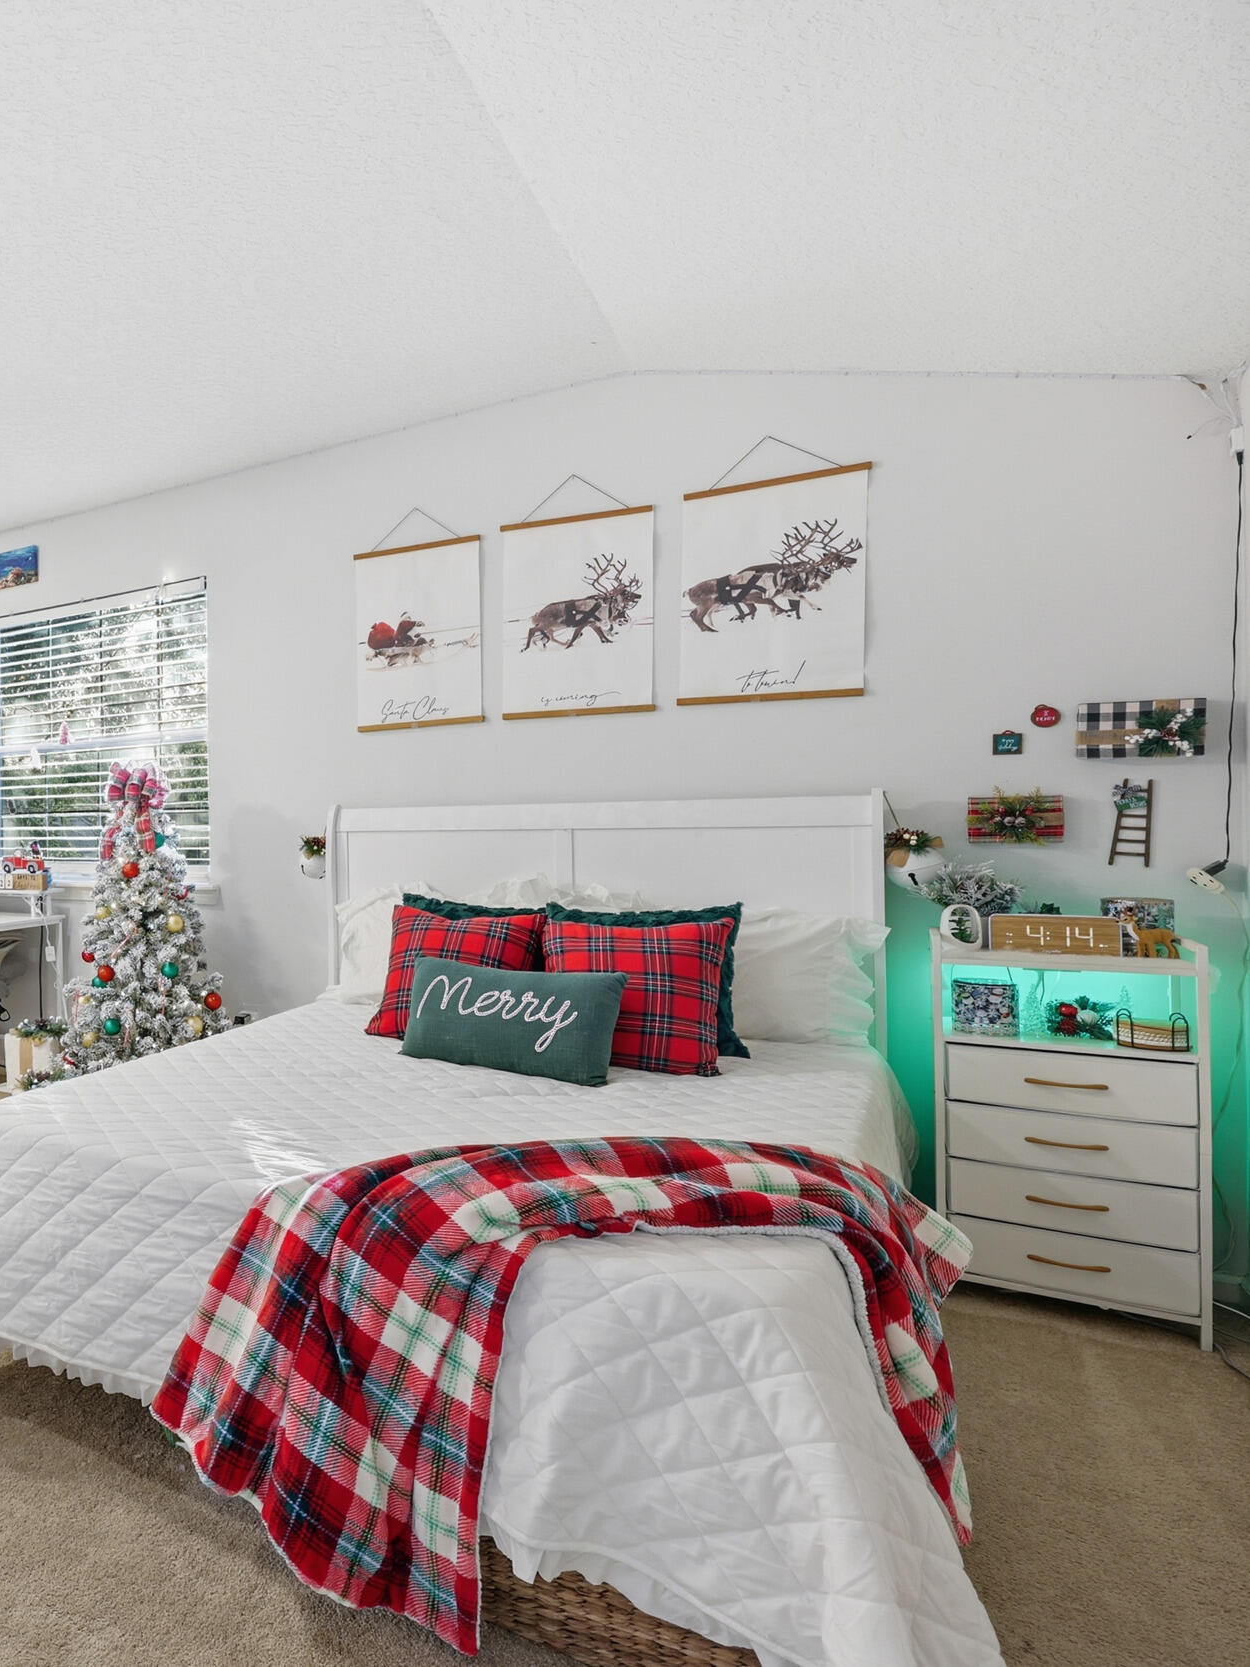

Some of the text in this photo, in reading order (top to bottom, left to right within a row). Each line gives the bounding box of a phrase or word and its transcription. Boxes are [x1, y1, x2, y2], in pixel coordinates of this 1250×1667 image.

[381, 695, 450, 723] Santa Claus
[1026, 925, 1094, 948] 4:14
[416, 975, 578, 1053] Merry
